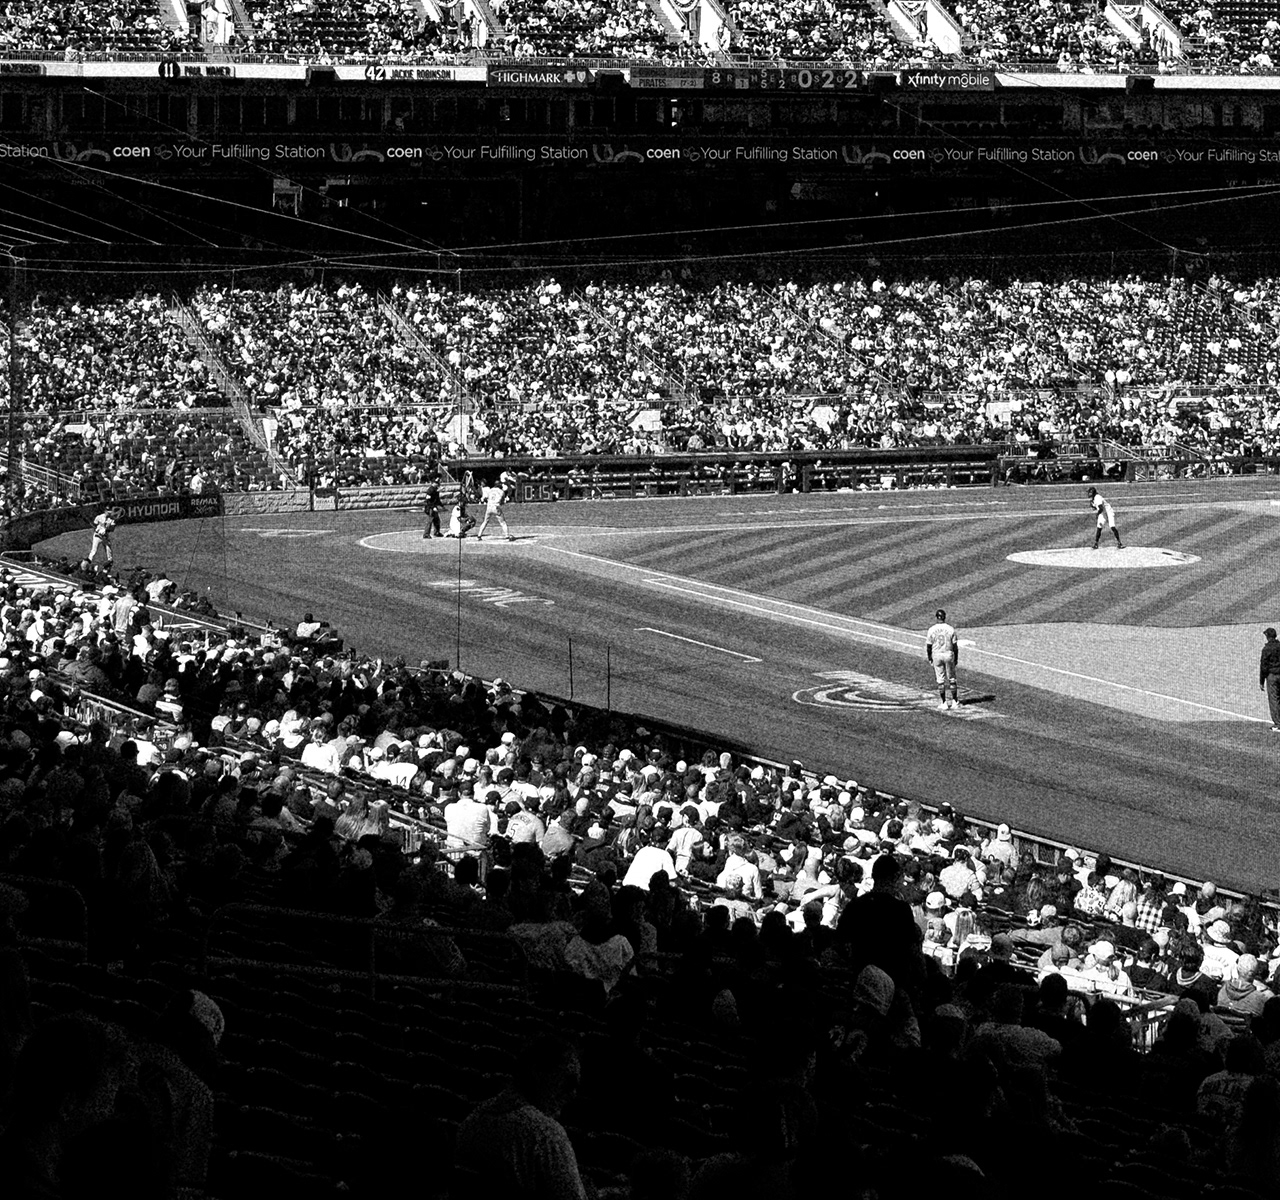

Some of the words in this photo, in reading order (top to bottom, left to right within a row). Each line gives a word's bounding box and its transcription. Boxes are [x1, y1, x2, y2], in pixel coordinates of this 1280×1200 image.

[164, 63, 174, 77] 11
[366, 66, 384, 79] 42
[391, 69, 414, 79] JACKIE
[417, 69, 452, 80] ROBINSON
[498, 72, 560, 83] HIGHMARK
[712, 72, 720, 84] 8
[639, 79, 666, 88] PIRATES
[798, 70, 812, 88] 0
[822, 71, 834, 88] 2
[845, 71, 857, 88] 2
[908, 74, 946, 88] xfinity
[113, 145, 151, 158] coen
[172, 144, 208, 158] Your
[211, 143, 270, 161] Fulfilling
[274, 144, 325, 158] Station
[386, 145, 423, 158] coen
[443, 145, 476, 159] Your
[480, 144, 536, 162] Fulfilling
[540, 145, 588, 160] Station
[646, 146, 680, 159] coen
[699, 146, 731, 160] Your
[735, 145, 788, 162] Fulfilling
[792, 146, 838, 160] Station
[892, 147, 926, 160] coen
[943, 147, 973, 161] Your
[977, 147, 1028, 163] Fulfilling
[1031, 147, 1075, 161] Station
[1127, 149, 1158, 161] coen
[1175, 148, 1204, 162] Your
[1207, 148, 1256, 164] Fulfilling
[525, 485, 550, 501] 0:15
[128, 502, 180, 518] HYUNDAI
